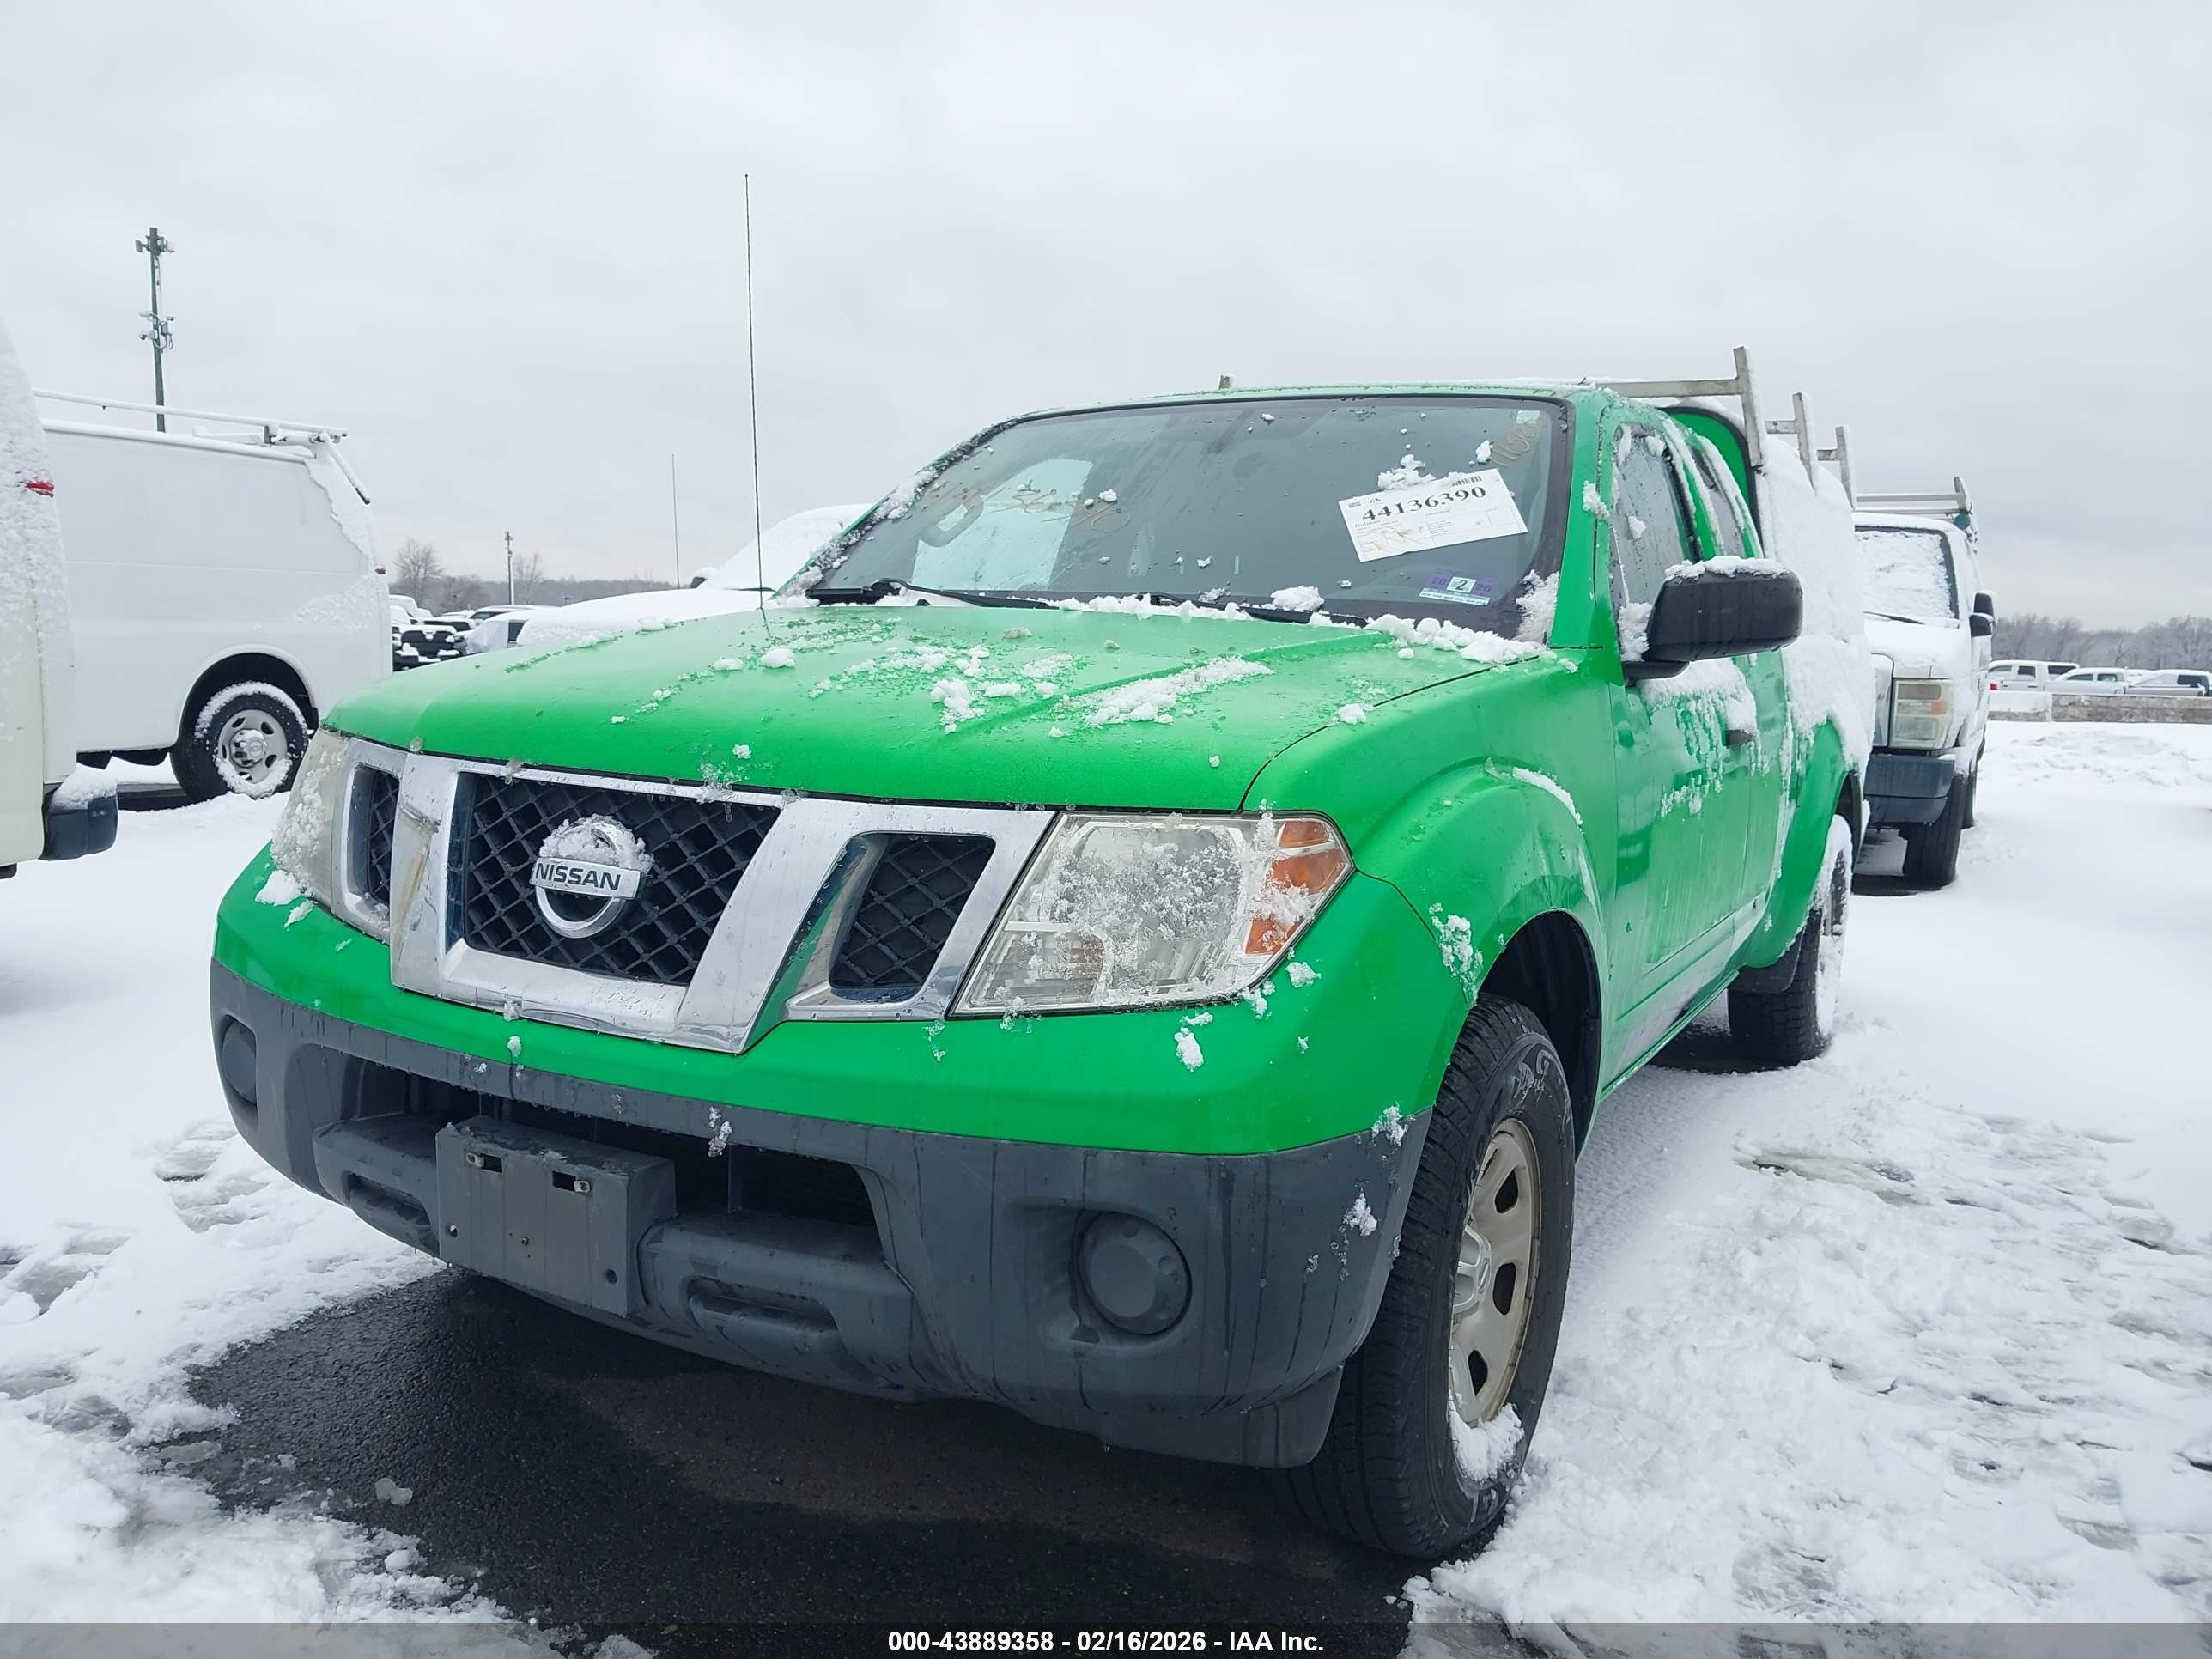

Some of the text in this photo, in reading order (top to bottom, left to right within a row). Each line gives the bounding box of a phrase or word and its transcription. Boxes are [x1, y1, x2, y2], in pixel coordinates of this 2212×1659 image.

[1362, 486, 1486, 520] 44136390
[1431, 576, 1448, 586] 20
[1455, 580, 1468, 591] 2
[535, 862, 622, 891] NISSAN
